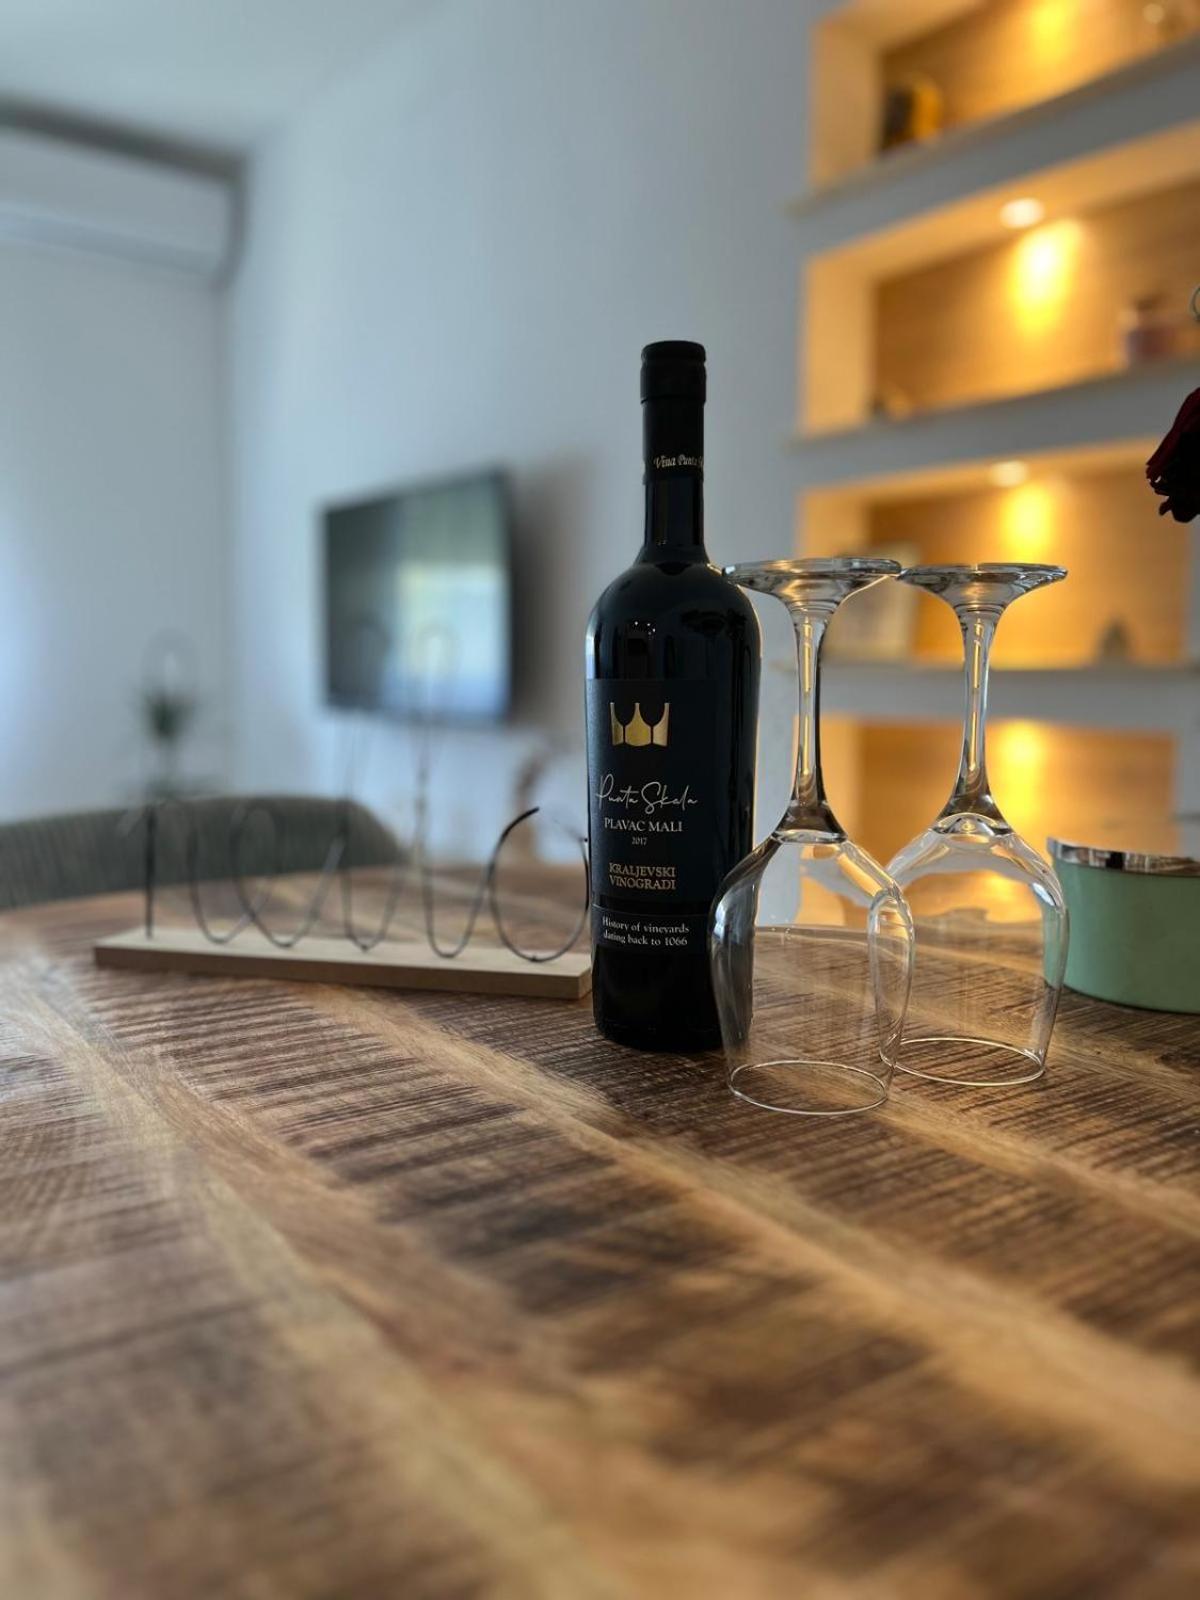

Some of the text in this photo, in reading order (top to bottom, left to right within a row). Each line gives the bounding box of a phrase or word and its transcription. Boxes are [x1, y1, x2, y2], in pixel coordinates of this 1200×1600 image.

[653, 455, 676, 469] Vina
[595, 773, 698, 815] Punta Skala
[604, 817, 683, 833] PLAVAC MALI
[631, 836, 648, 846] 2017
[609, 862, 676, 878] KRALJEVSKI
[609, 874, 676, 890] VINOGRADI
[602, 915, 690, 934] History of vineyards
[603, 929, 688, 946] dating back to 1066
